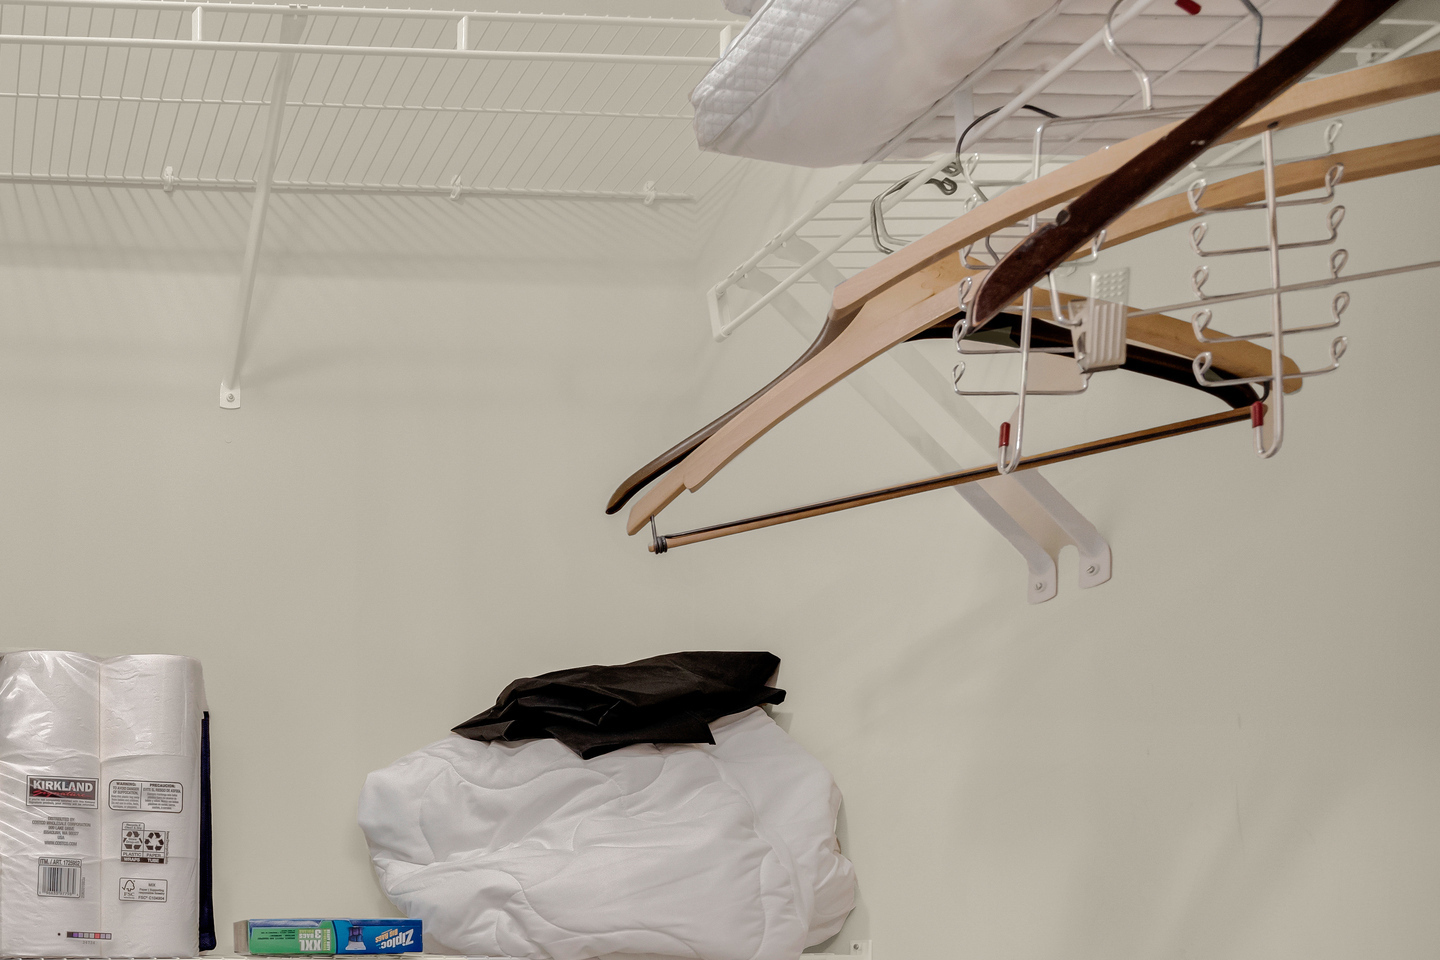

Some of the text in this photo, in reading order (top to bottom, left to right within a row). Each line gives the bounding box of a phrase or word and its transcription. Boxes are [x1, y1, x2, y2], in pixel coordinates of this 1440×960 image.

[33, 780, 94, 792] KIRKLAND
[33, 789, 92, 798] Signature
[314, 929, 322, 939] 3
[375, 932, 389, 943] BAGS
[380, 928, 414, 949] Ziploc
[299, 939, 322, 951] XXL
